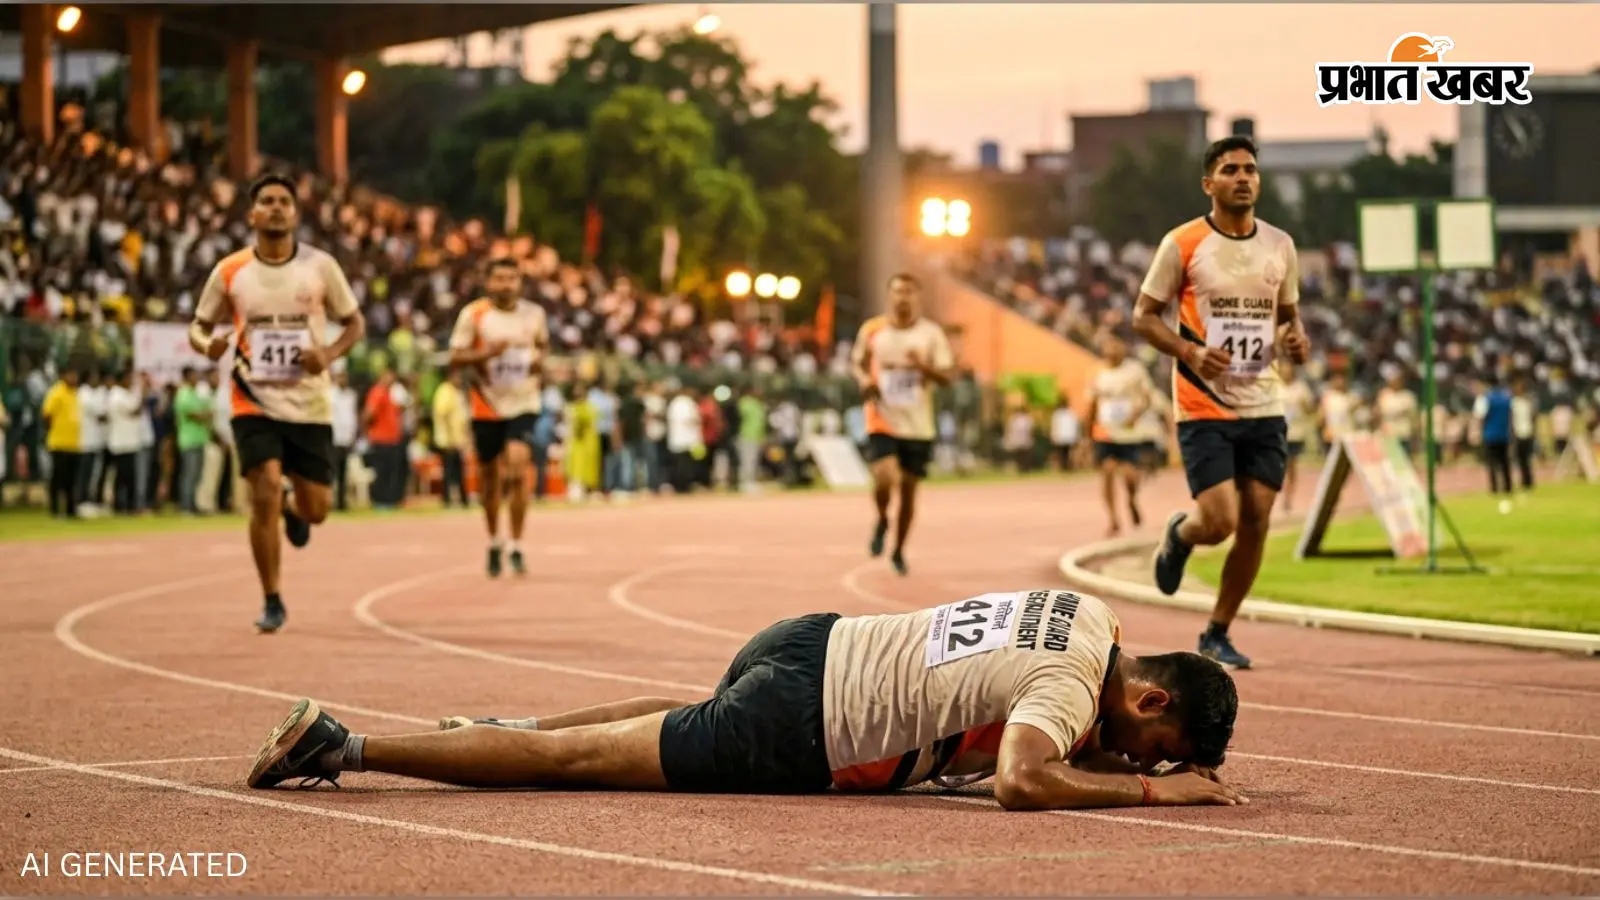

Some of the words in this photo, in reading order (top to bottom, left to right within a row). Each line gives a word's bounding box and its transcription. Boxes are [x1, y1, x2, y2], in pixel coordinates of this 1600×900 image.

[260, 344, 303, 366] 412
[1220, 336, 1263, 361] 412
[947, 599, 993, 652] 412
